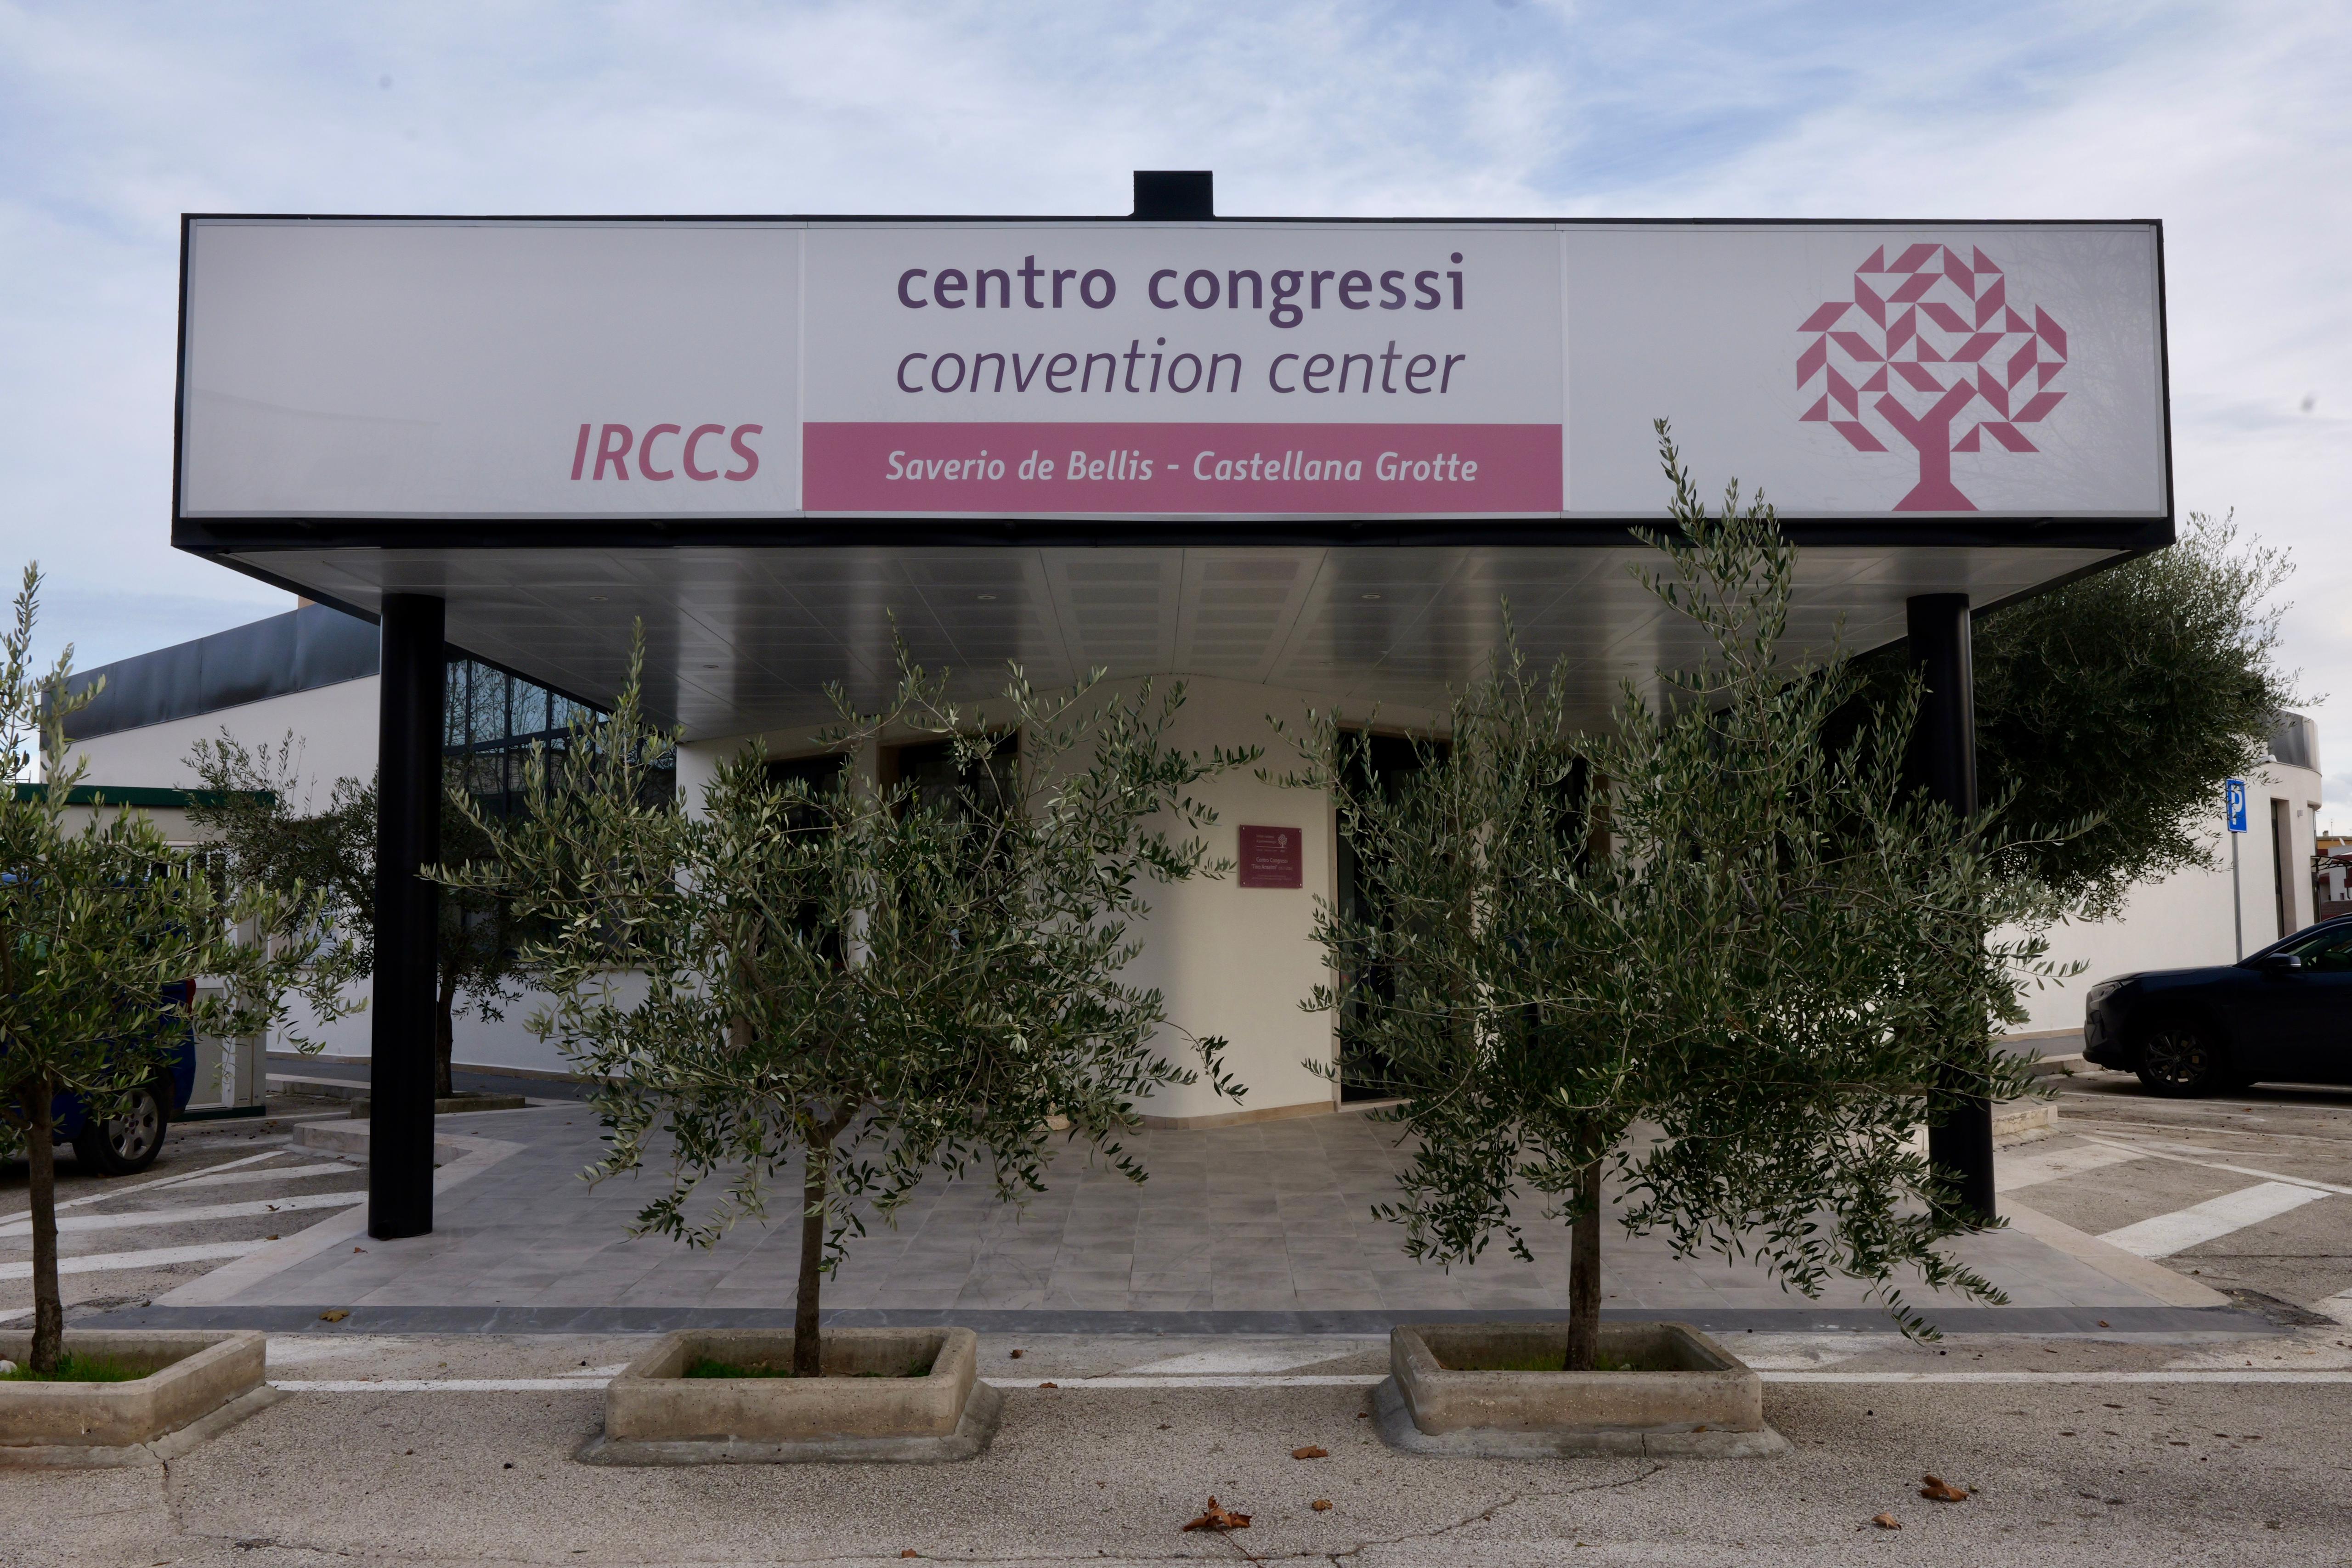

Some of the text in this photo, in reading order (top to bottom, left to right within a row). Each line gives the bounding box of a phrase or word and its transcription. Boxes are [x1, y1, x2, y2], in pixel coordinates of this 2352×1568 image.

[898, 252, 1463, 328] centro congressi
[897, 337, 1465, 394] convention center
[571, 423, 763, 481] IRCCS
[886, 450, 1005, 479] Saverio
[1018, 450, 1054, 479] de
[1067, 450, 1153, 480] Bellis
[1193, 450, 1362, 480] Castellana
[1376, 451, 1478, 481] Grotte
[2231, 784, 2243, 825] P
